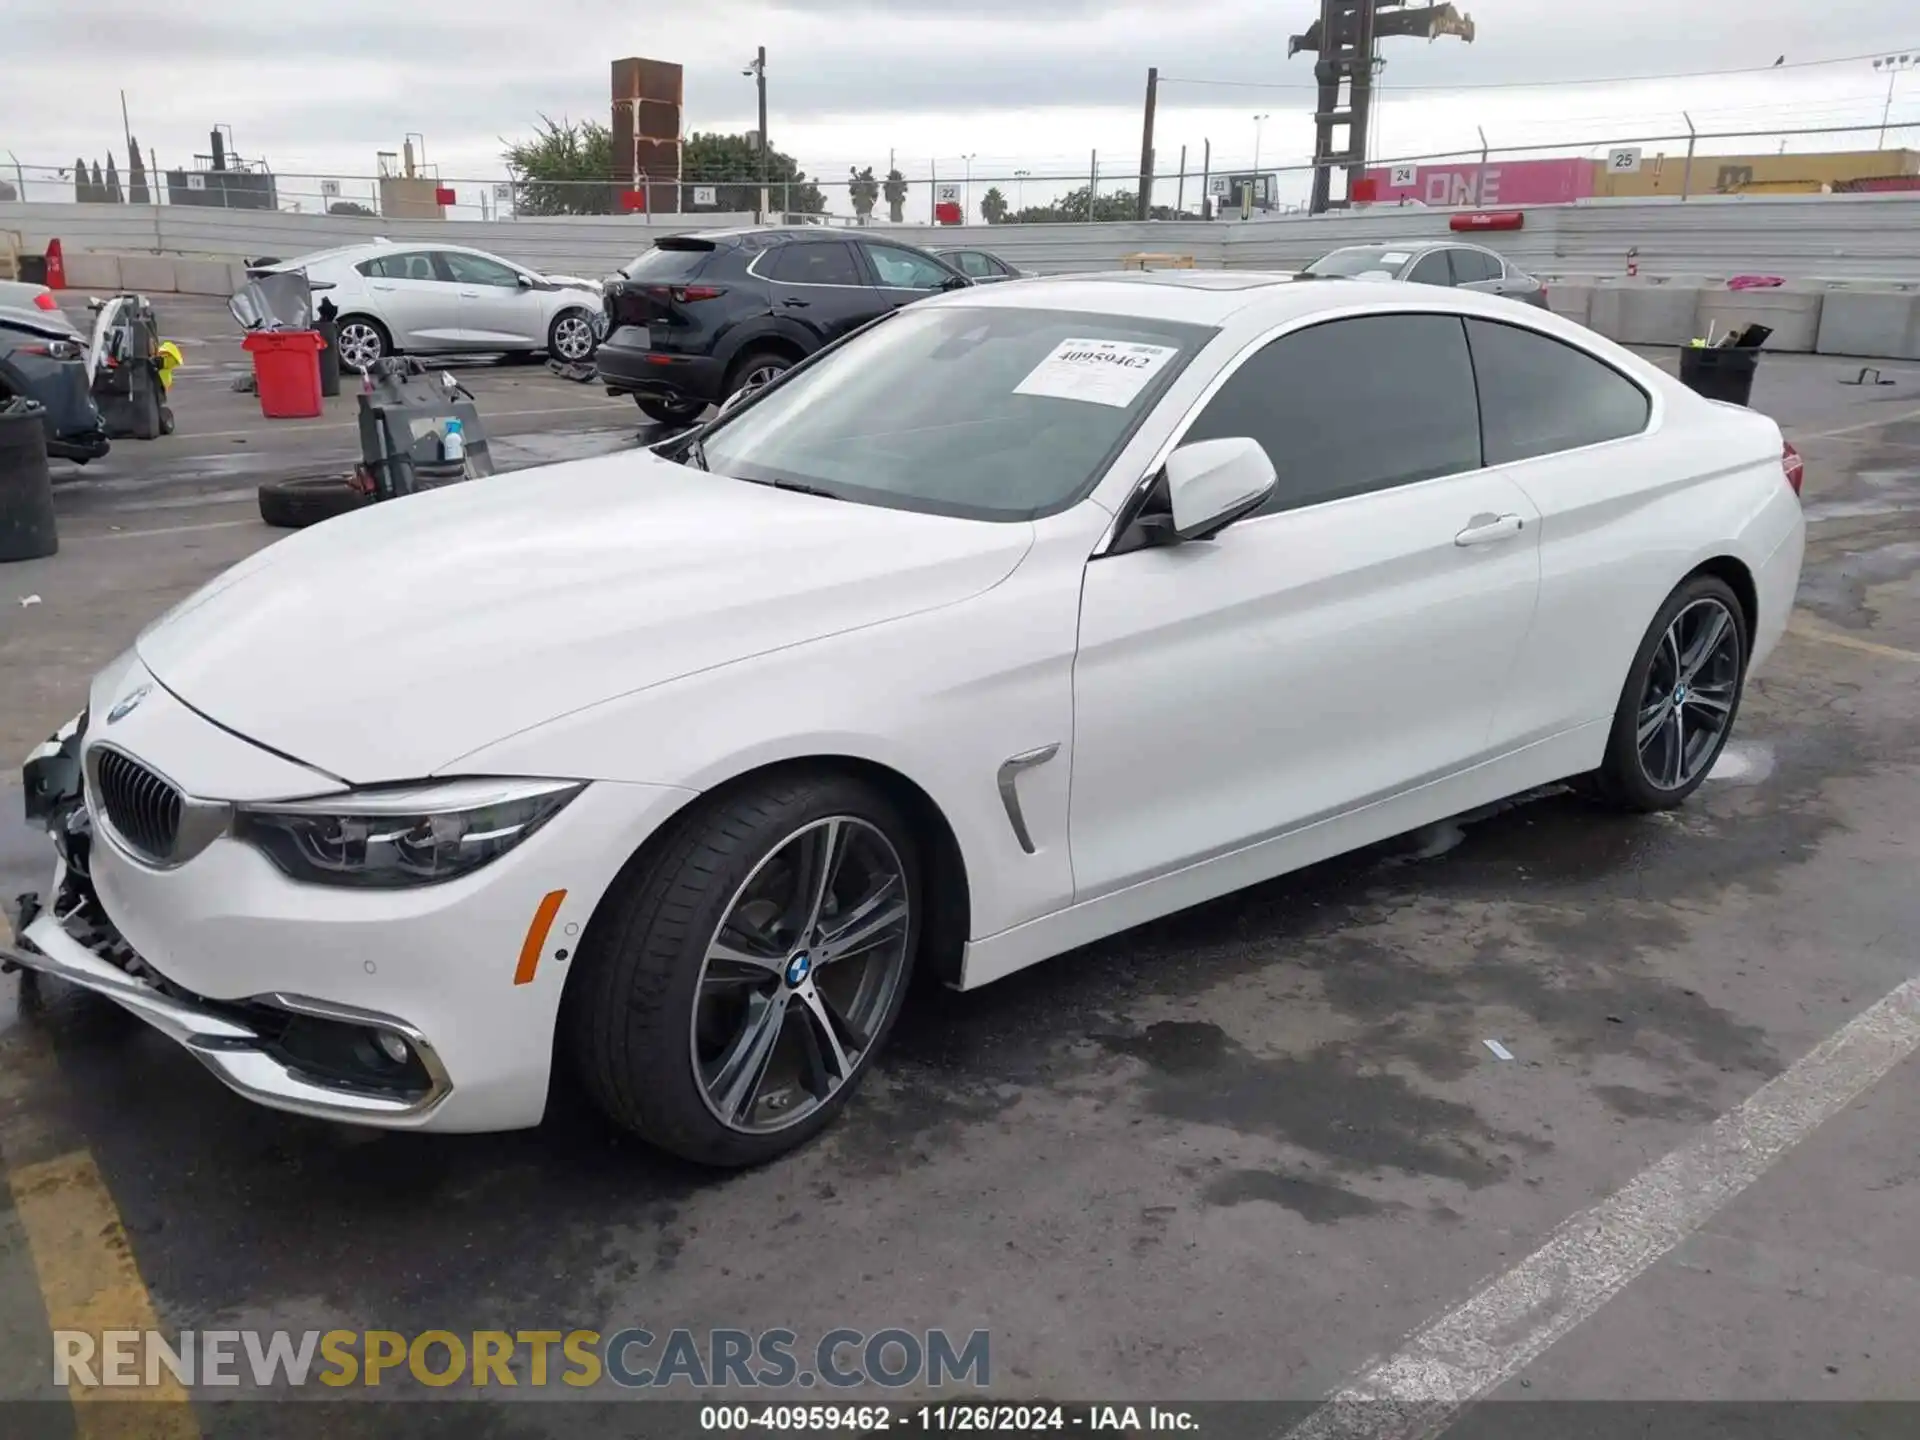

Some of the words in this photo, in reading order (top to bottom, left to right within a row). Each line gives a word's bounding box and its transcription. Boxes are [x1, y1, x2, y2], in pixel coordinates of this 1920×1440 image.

[1615, 153, 1633, 168] 25
[1396, 169, 1410, 182] 24
[941, 188, 955, 199] 22
[1426, 171, 1500, 204] ONE
[698, 190, 710, 201] 21
